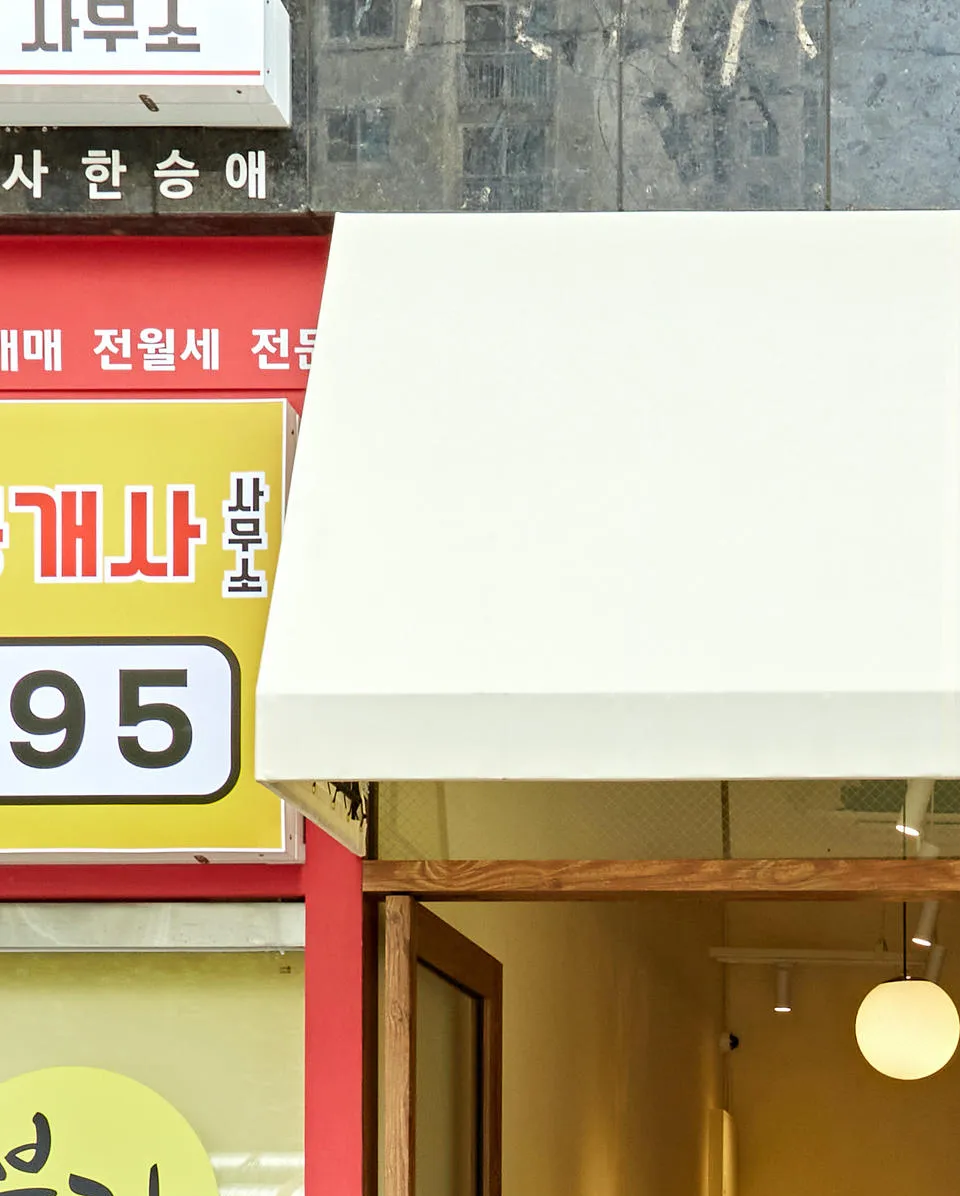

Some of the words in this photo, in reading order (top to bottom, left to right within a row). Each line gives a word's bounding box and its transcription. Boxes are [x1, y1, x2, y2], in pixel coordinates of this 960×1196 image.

[22, 0, 200, 52] 사무소
[93, 327, 219, 372] 전월세
[0, 490, 200, 577] 개사
[227, 477, 264, 593] 사무소
[9, 668, 194, 770] 95
